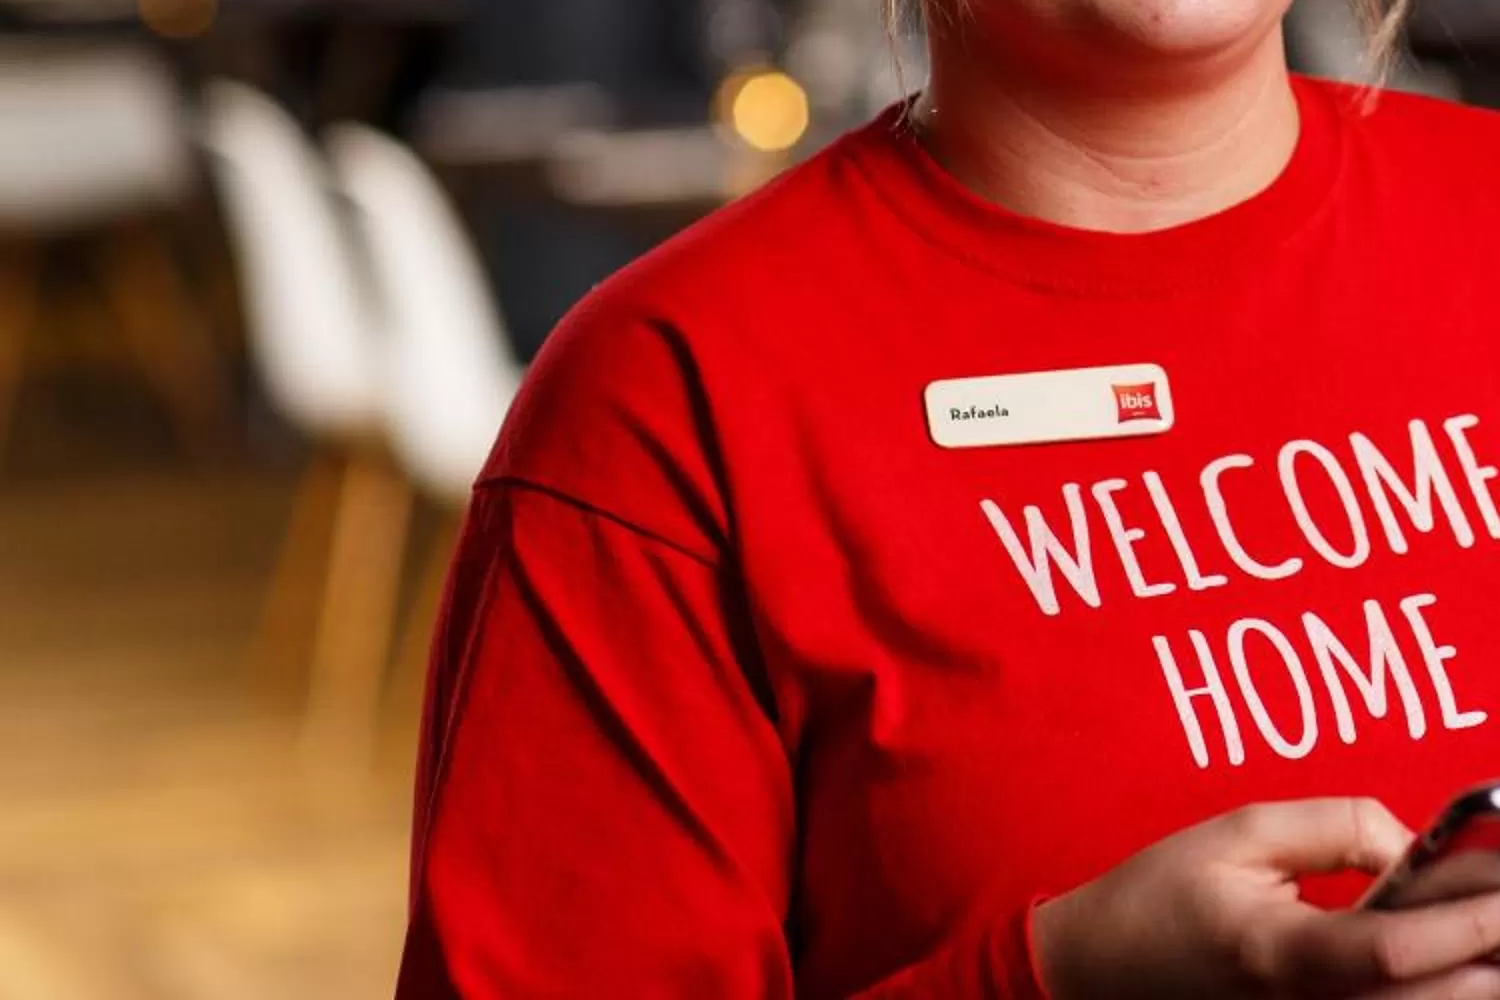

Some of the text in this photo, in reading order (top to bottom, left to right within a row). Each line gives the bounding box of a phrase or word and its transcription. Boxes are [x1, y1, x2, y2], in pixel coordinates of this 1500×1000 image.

[1119, 392, 1153, 409] ibis
[949, 405, 1009, 421] Rafaela
[1152, 593, 1488, 769] HOME
